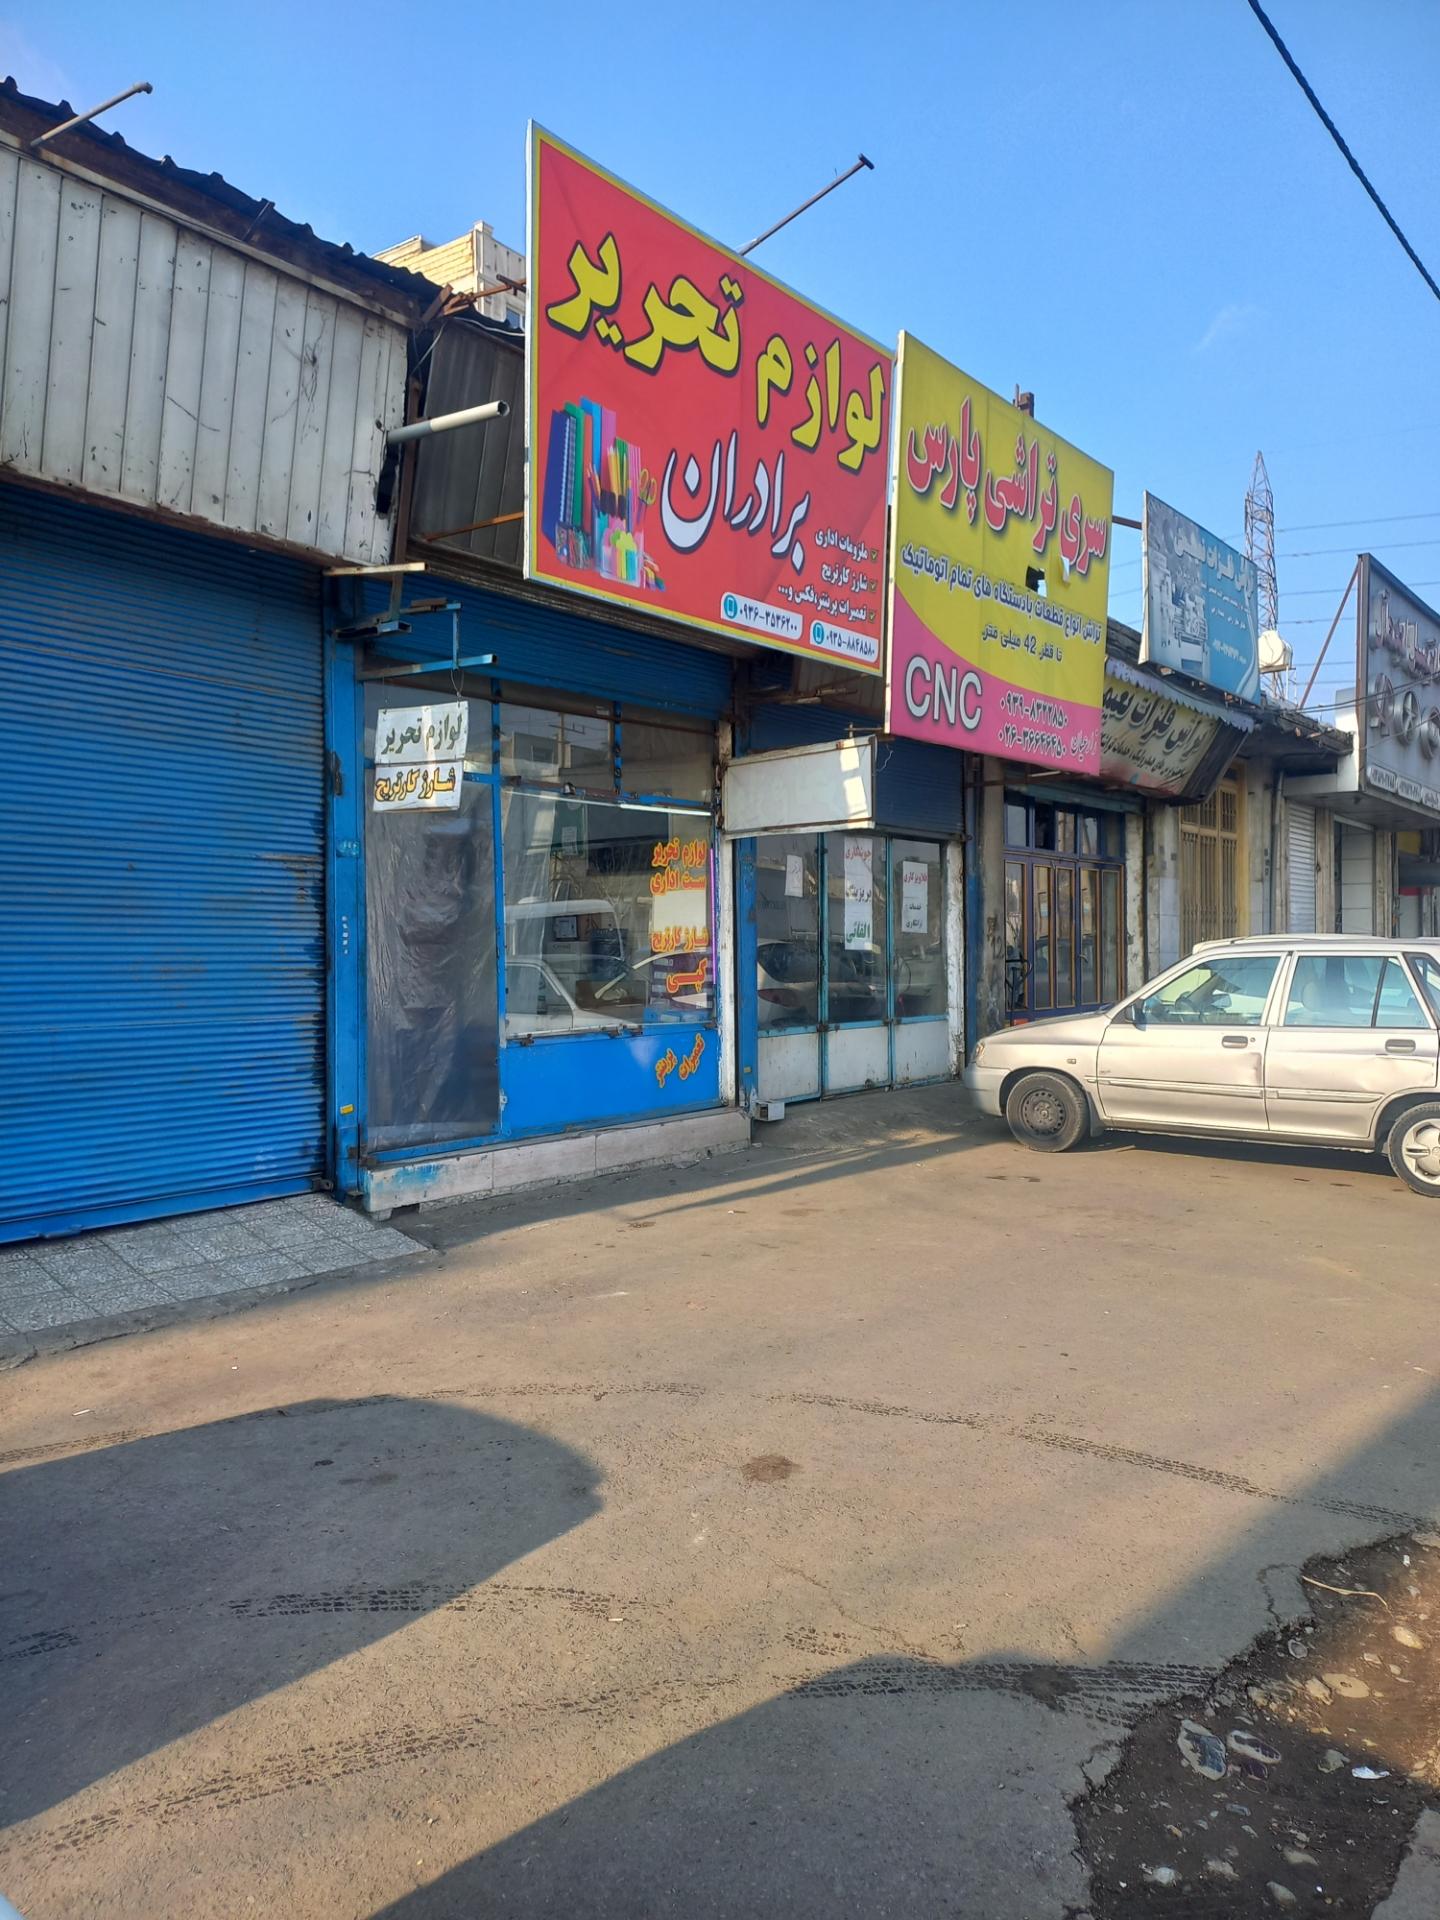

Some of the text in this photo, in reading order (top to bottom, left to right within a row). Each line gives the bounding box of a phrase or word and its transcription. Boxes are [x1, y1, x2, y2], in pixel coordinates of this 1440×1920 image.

[547, 233, 884, 470] لوازم تحریر
[660, 431, 810, 574] برادران
[906, 396, 1108, 575] سری تراشی پارس
[815, 528, 869, 562] ملزومات اداری
[902, 544, 948, 582] اتوماتیک
[949, 564, 973, 592] تمام
[973, 575, 992, 600] های
[1035, 600, 1064, 627] قطعات
[1024, 633, 1037, 656] 42
[905, 655, 983, 730] CNC
[381, 714, 462, 755] لوازم تحریر
[375, 767, 456, 802] شارژ کارتریج
[651, 837, 707, 868] لوازم تحریر
[650, 866, 680, 896] اداری
